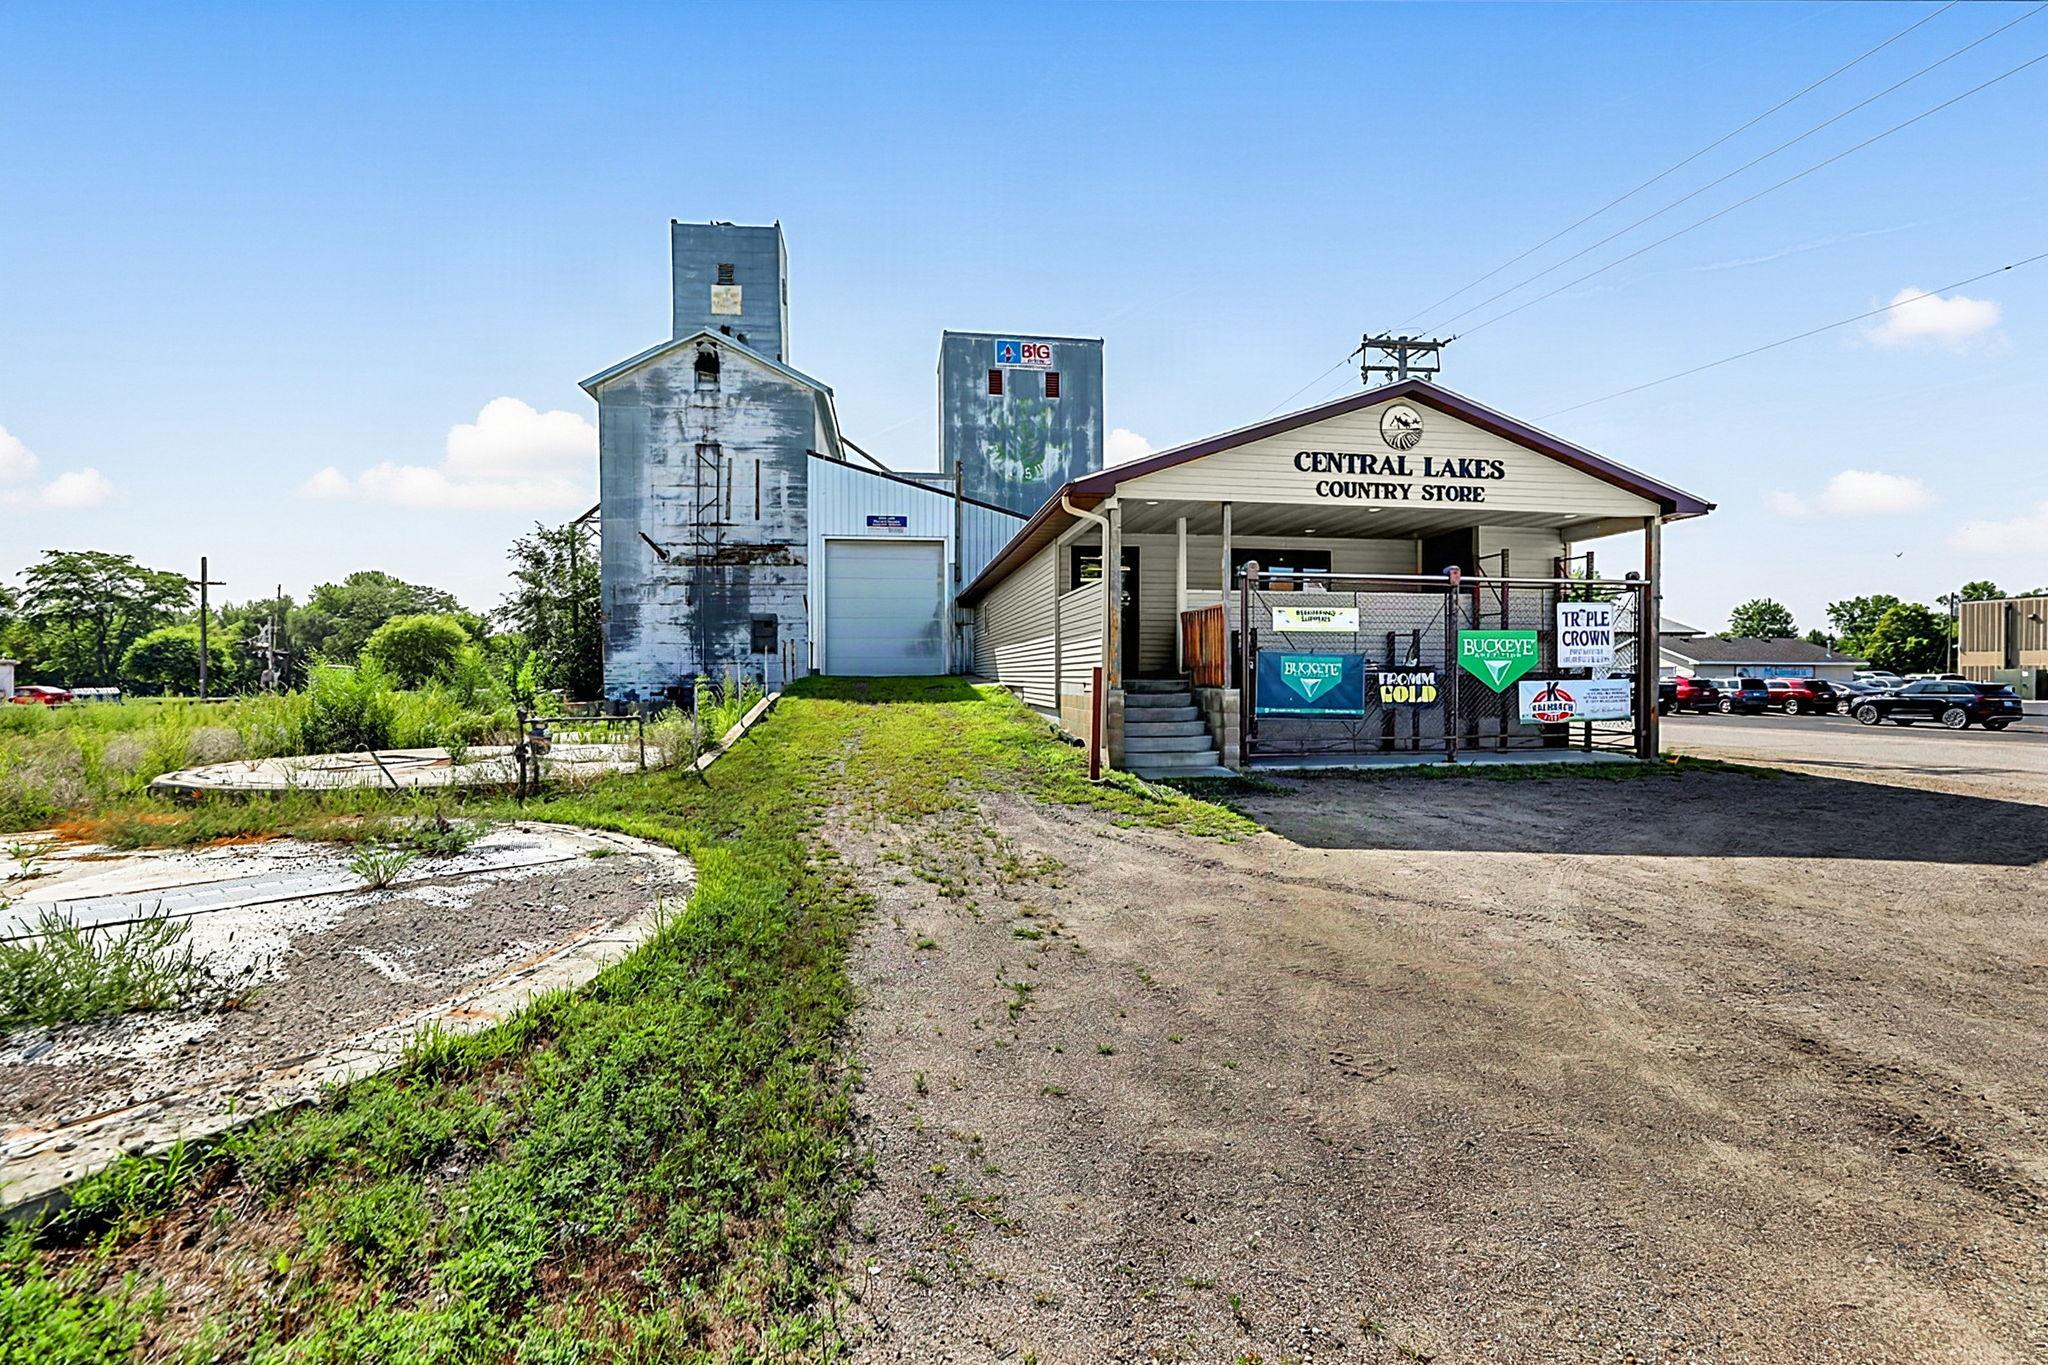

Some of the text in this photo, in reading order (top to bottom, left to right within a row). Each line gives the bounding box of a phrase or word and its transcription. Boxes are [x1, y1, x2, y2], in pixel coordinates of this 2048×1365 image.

[1294, 451, 1505, 480] CENTRAL LAKES
[1316, 481, 1485, 502] COUNTRY STORE
[1463, 638, 1536, 655] BUCKEYE
[1562, 630, 1610, 647] CROWN
